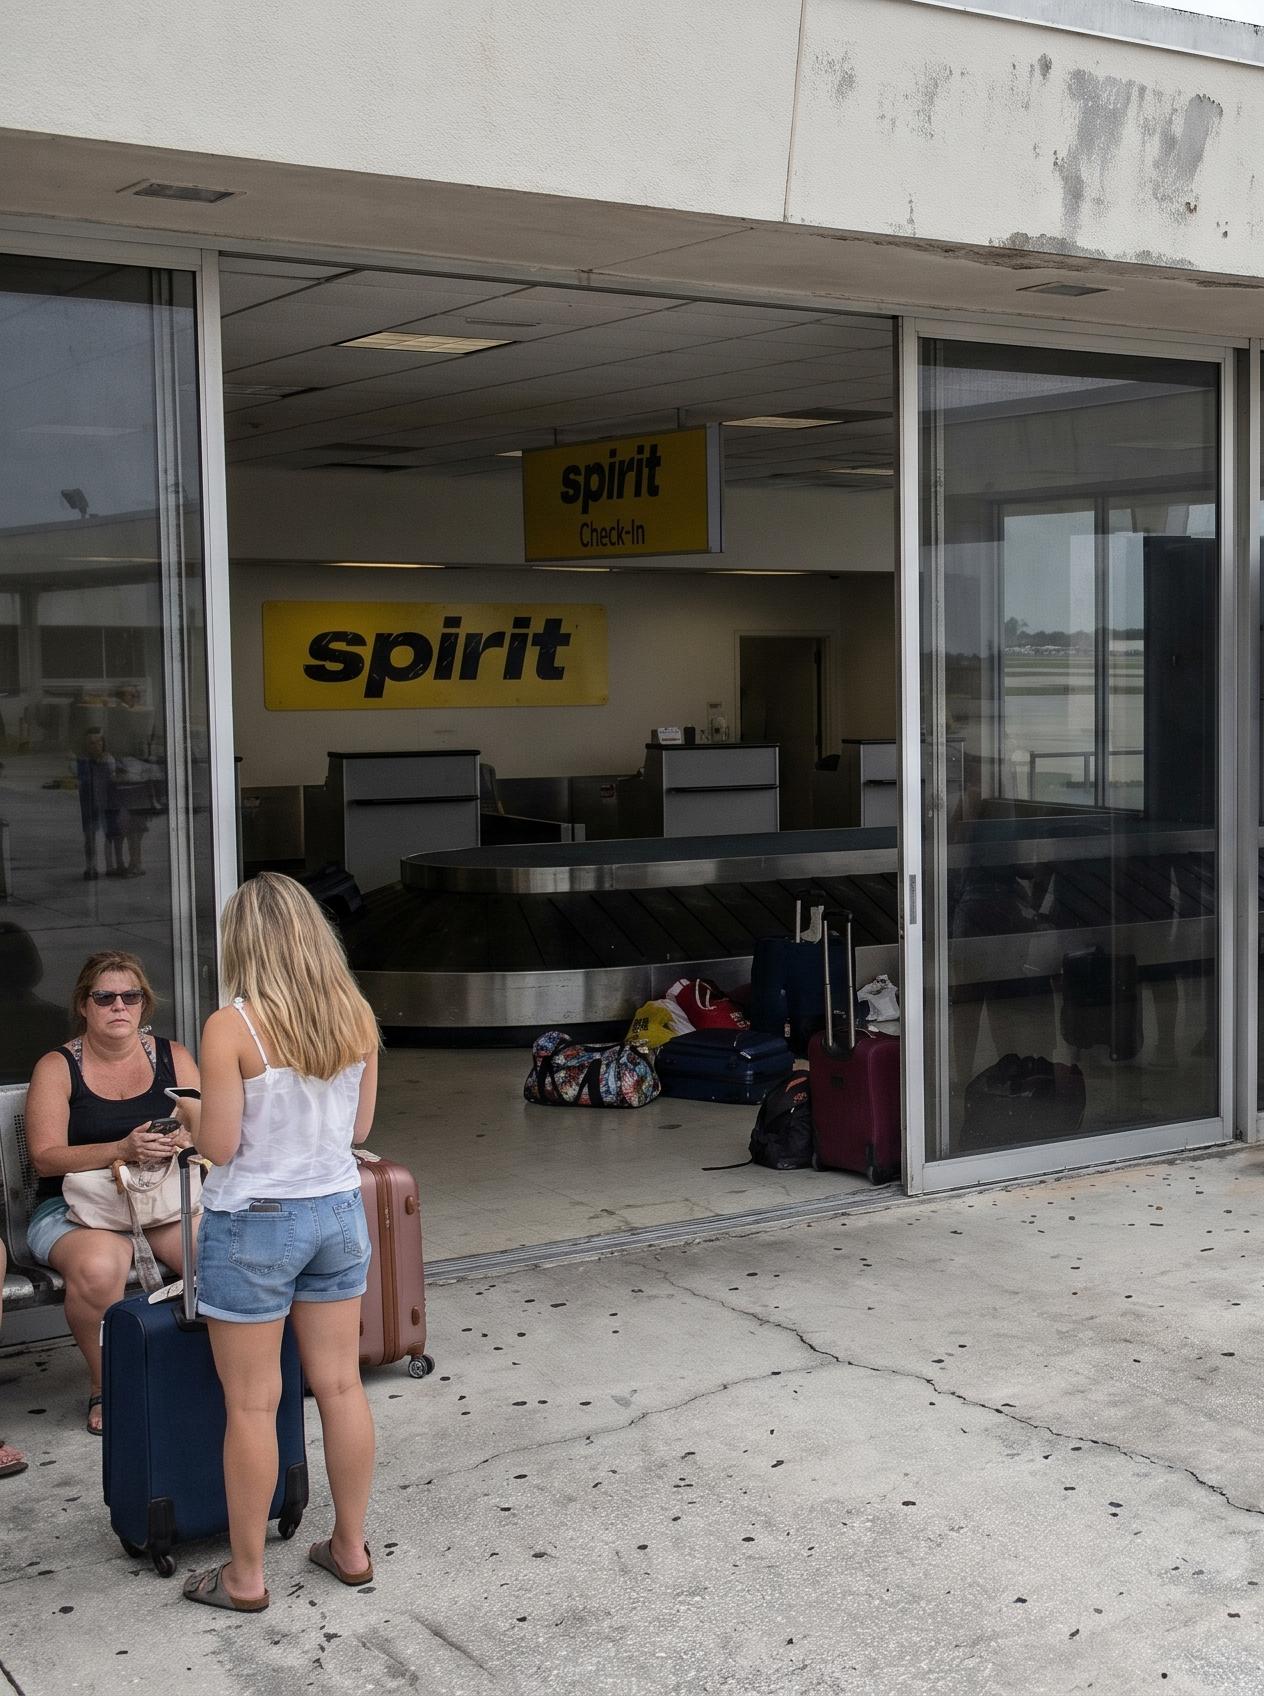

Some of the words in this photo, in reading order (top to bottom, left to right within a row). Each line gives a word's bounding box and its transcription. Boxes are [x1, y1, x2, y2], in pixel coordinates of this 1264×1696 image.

[560, 444, 662, 514] spirit
[580, 519, 645, 548] Check-In
[303, 616, 572, 698] spirit
